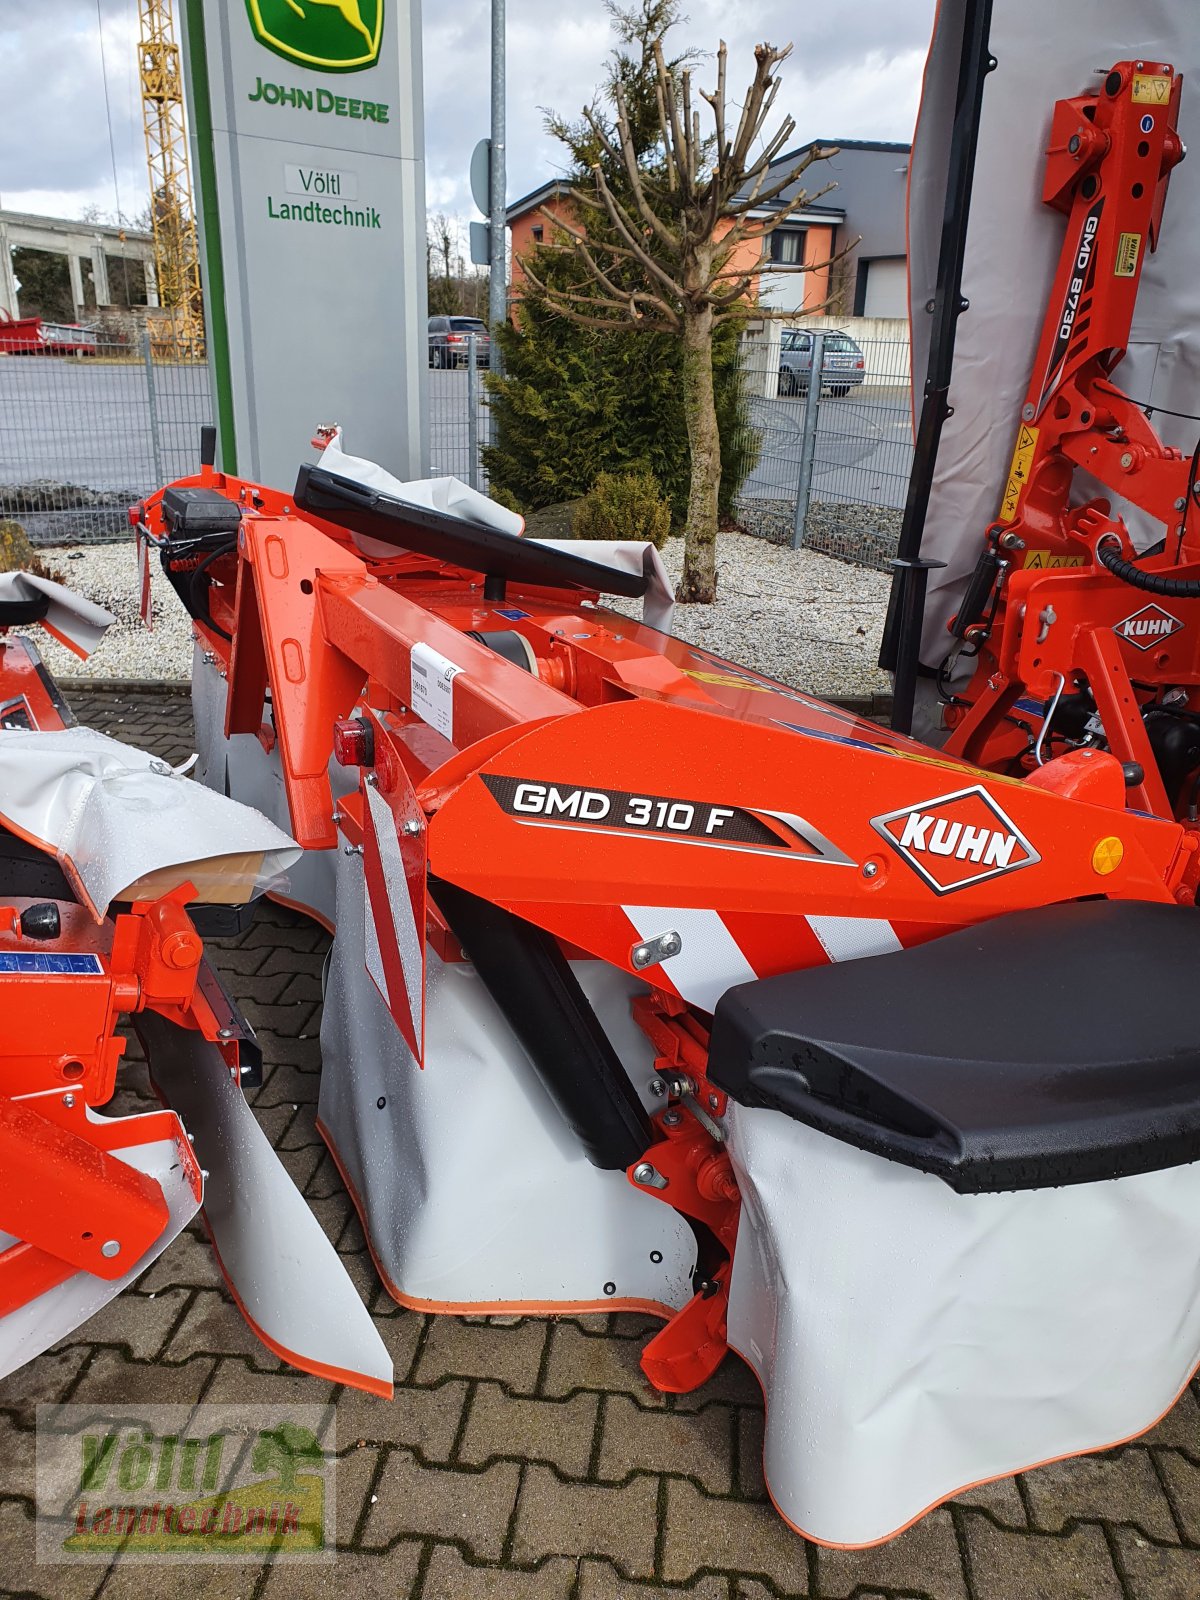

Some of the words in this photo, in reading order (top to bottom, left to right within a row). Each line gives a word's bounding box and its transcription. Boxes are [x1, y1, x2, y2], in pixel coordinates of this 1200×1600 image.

[248, 76, 313, 111] JOHN
[316, 88, 390, 124] DEERE
[298, 168, 341, 195] Völtl
[267, 196, 381, 229] Landtechnik
[1077, 216, 1099, 269] GMD
[1059, 277, 1083, 340] 8730
[1123, 619, 1174, 636] KUHN
[513, 783, 610, 820] GMD
[624, 798, 695, 831] 310
[705, 808, 734, 834] F
[899, 812, 1017, 868] KUHN
